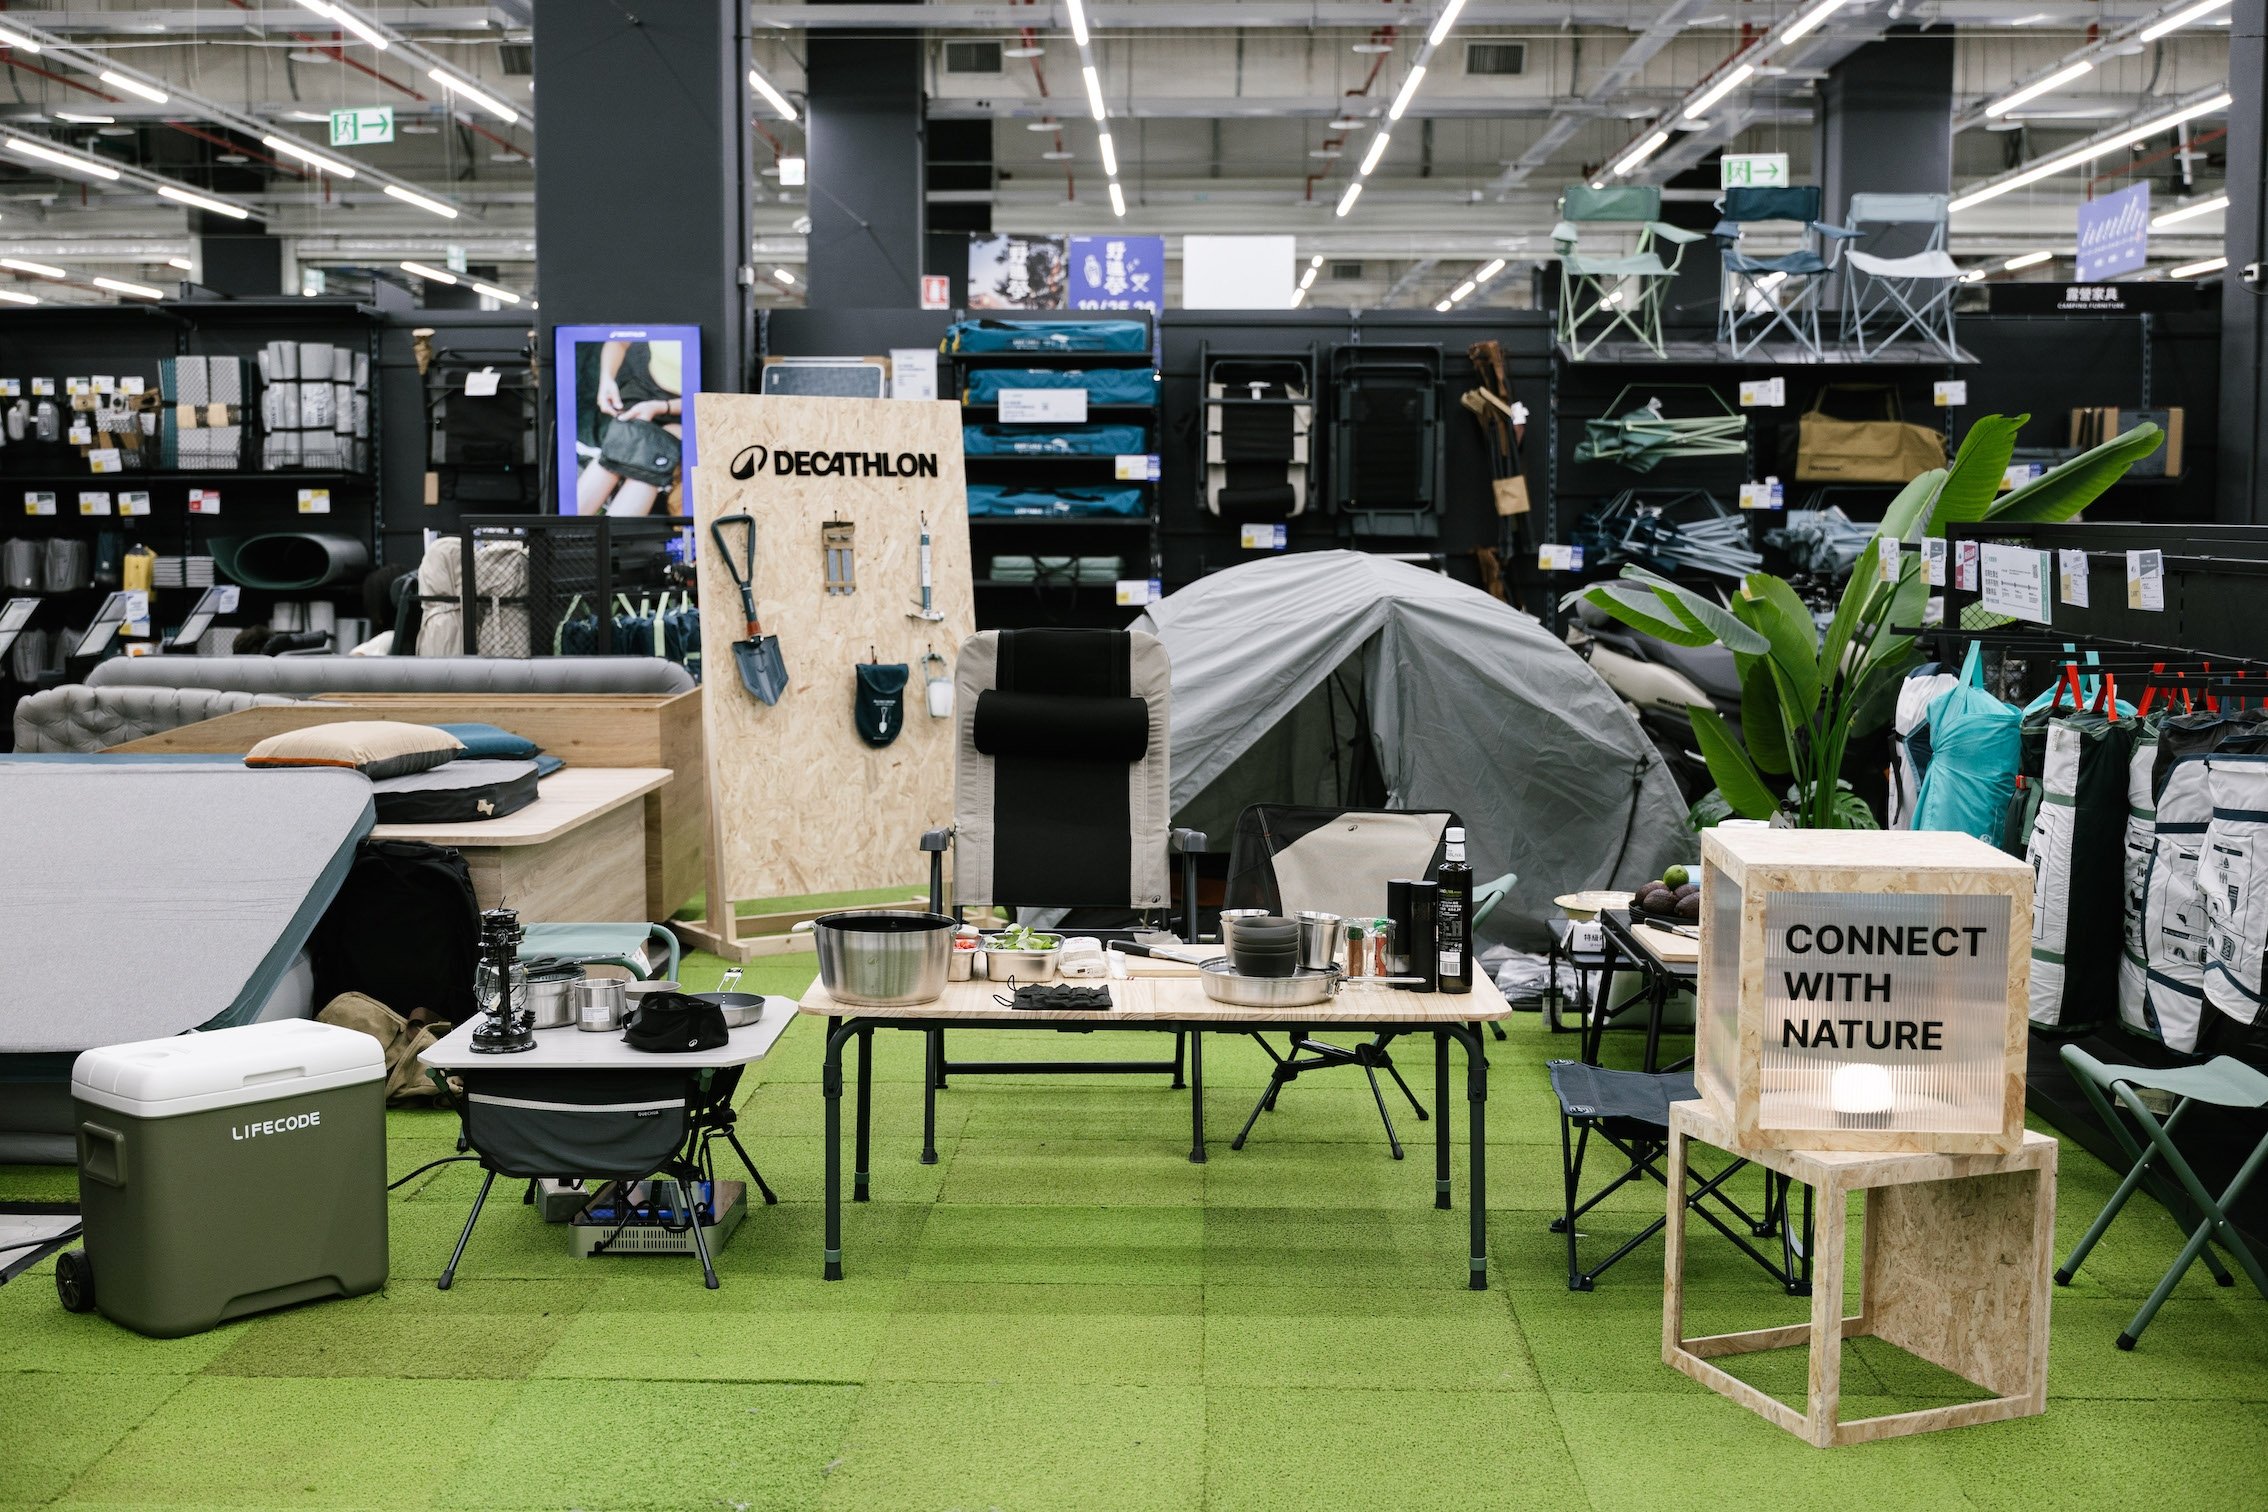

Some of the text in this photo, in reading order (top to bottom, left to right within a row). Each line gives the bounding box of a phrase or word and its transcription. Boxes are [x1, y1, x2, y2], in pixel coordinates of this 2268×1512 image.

[2057, 302, 2125, 310] CAMPING FURNITURE
[774, 451, 938, 477] DECATHLON
[1786, 924, 1987, 957] CONNECT
[1784, 972, 1891, 1003] WITH
[1782, 1019, 1943, 1051] NATURE
[232, 1111, 321, 1141] LIFECODE
